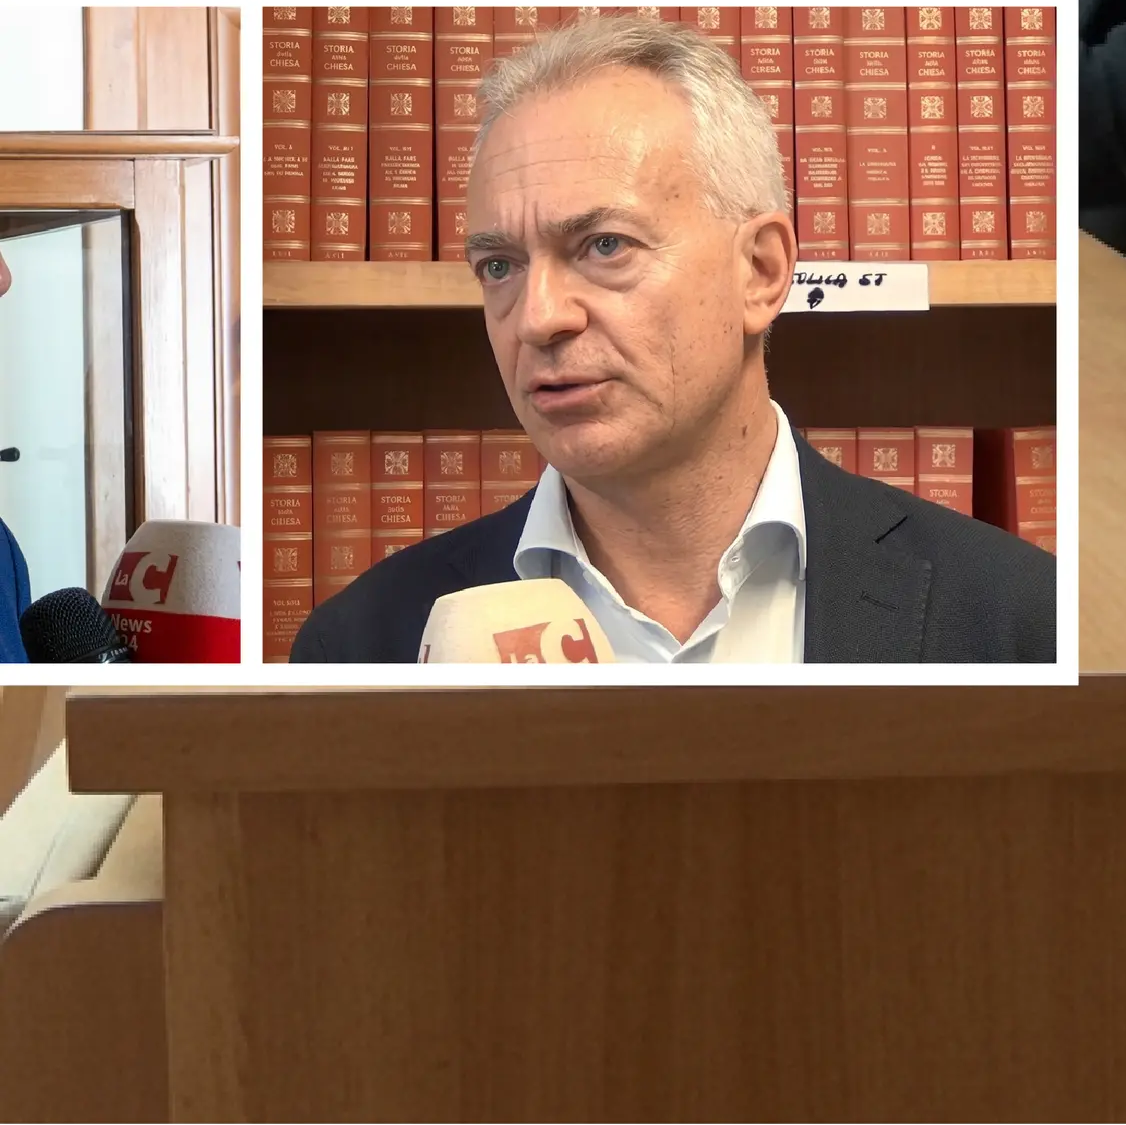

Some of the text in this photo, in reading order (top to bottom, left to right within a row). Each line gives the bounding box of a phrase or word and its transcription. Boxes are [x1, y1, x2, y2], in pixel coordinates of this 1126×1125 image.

[269, 41, 300, 49] STORIA
[323, 45, 354, 53] STORIA
[386, 45, 417, 53] STORIA
[449, 46, 480, 55] STORIA
[750, 48, 781, 56] STORIA
[804, 48, 835, 57] STORIA
[965, 49, 996, 57] STORIA
[1017, 50, 1046, 58] STORIA
[859, 51, 889, 59] STORIA
[918, 51, 945, 59] STORIA
[269, 59, 300, 67] CHIESA
[323, 62, 354, 71] CHIESA
[386, 63, 417, 71] CHIESA
[450, 64, 480, 72] CHIESA
[805, 66, 835, 74] CHIESA
[859, 68, 889, 76] CHIESA
[918, 68, 945, 76] CHIESA
[965, 66, 996, 75] CHIESA
[1017, 66, 1046, 75] CHIESA
[270, 499, 301, 507] STORIA
[381, 496, 411, 504] STORIA
[435, 495, 466, 503] STORIA
[271, 518, 301, 526] CHIESA
[381, 514, 411, 523] CHIESA
[110, 613, 153, 634] News
